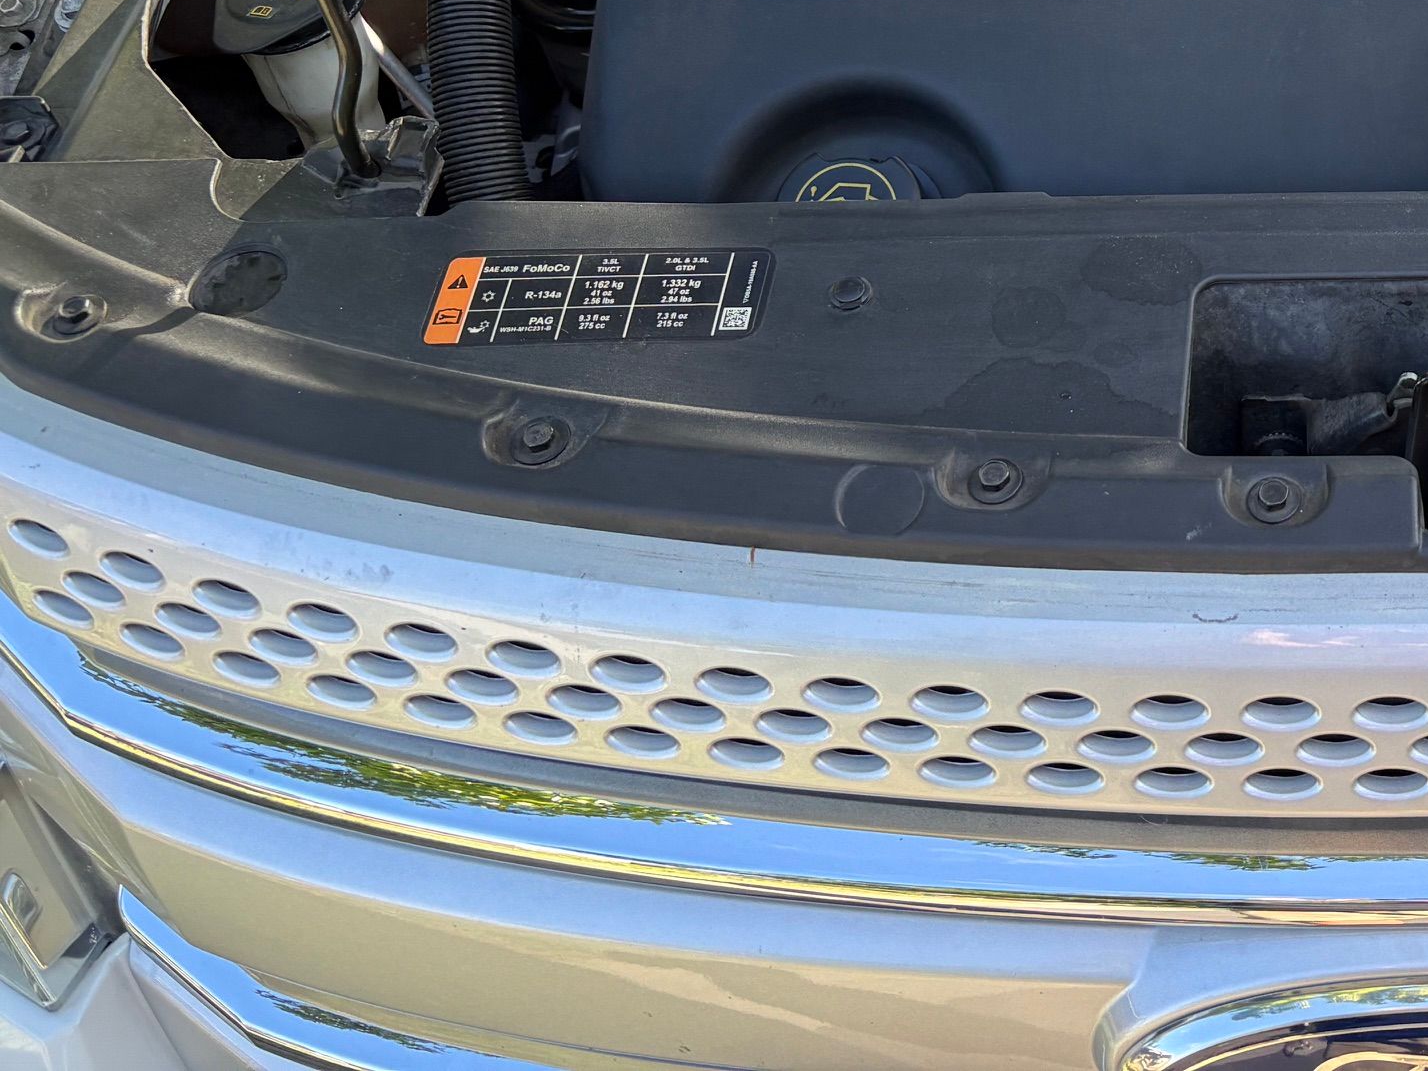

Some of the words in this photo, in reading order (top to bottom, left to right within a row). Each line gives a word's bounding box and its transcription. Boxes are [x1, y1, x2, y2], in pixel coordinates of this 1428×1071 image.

[522, 264, 571, 273] FoMoCo
[585, 281, 611, 289] 1.162
[611, 281, 624, 290] kg
[661, 279, 688, 288] 1.332
[688, 279, 702, 289] kg
[525, 290, 561, 299] R-134a
[679, 295, 693, 303] lbs
[578, 314, 591, 322] 9.3
[656, 312, 669, 320] 7.3
[670, 312, 677, 320] fl
[528, 316, 554, 325] PAG
[656, 320, 672, 328] 215
[578, 322, 594, 330] 275
